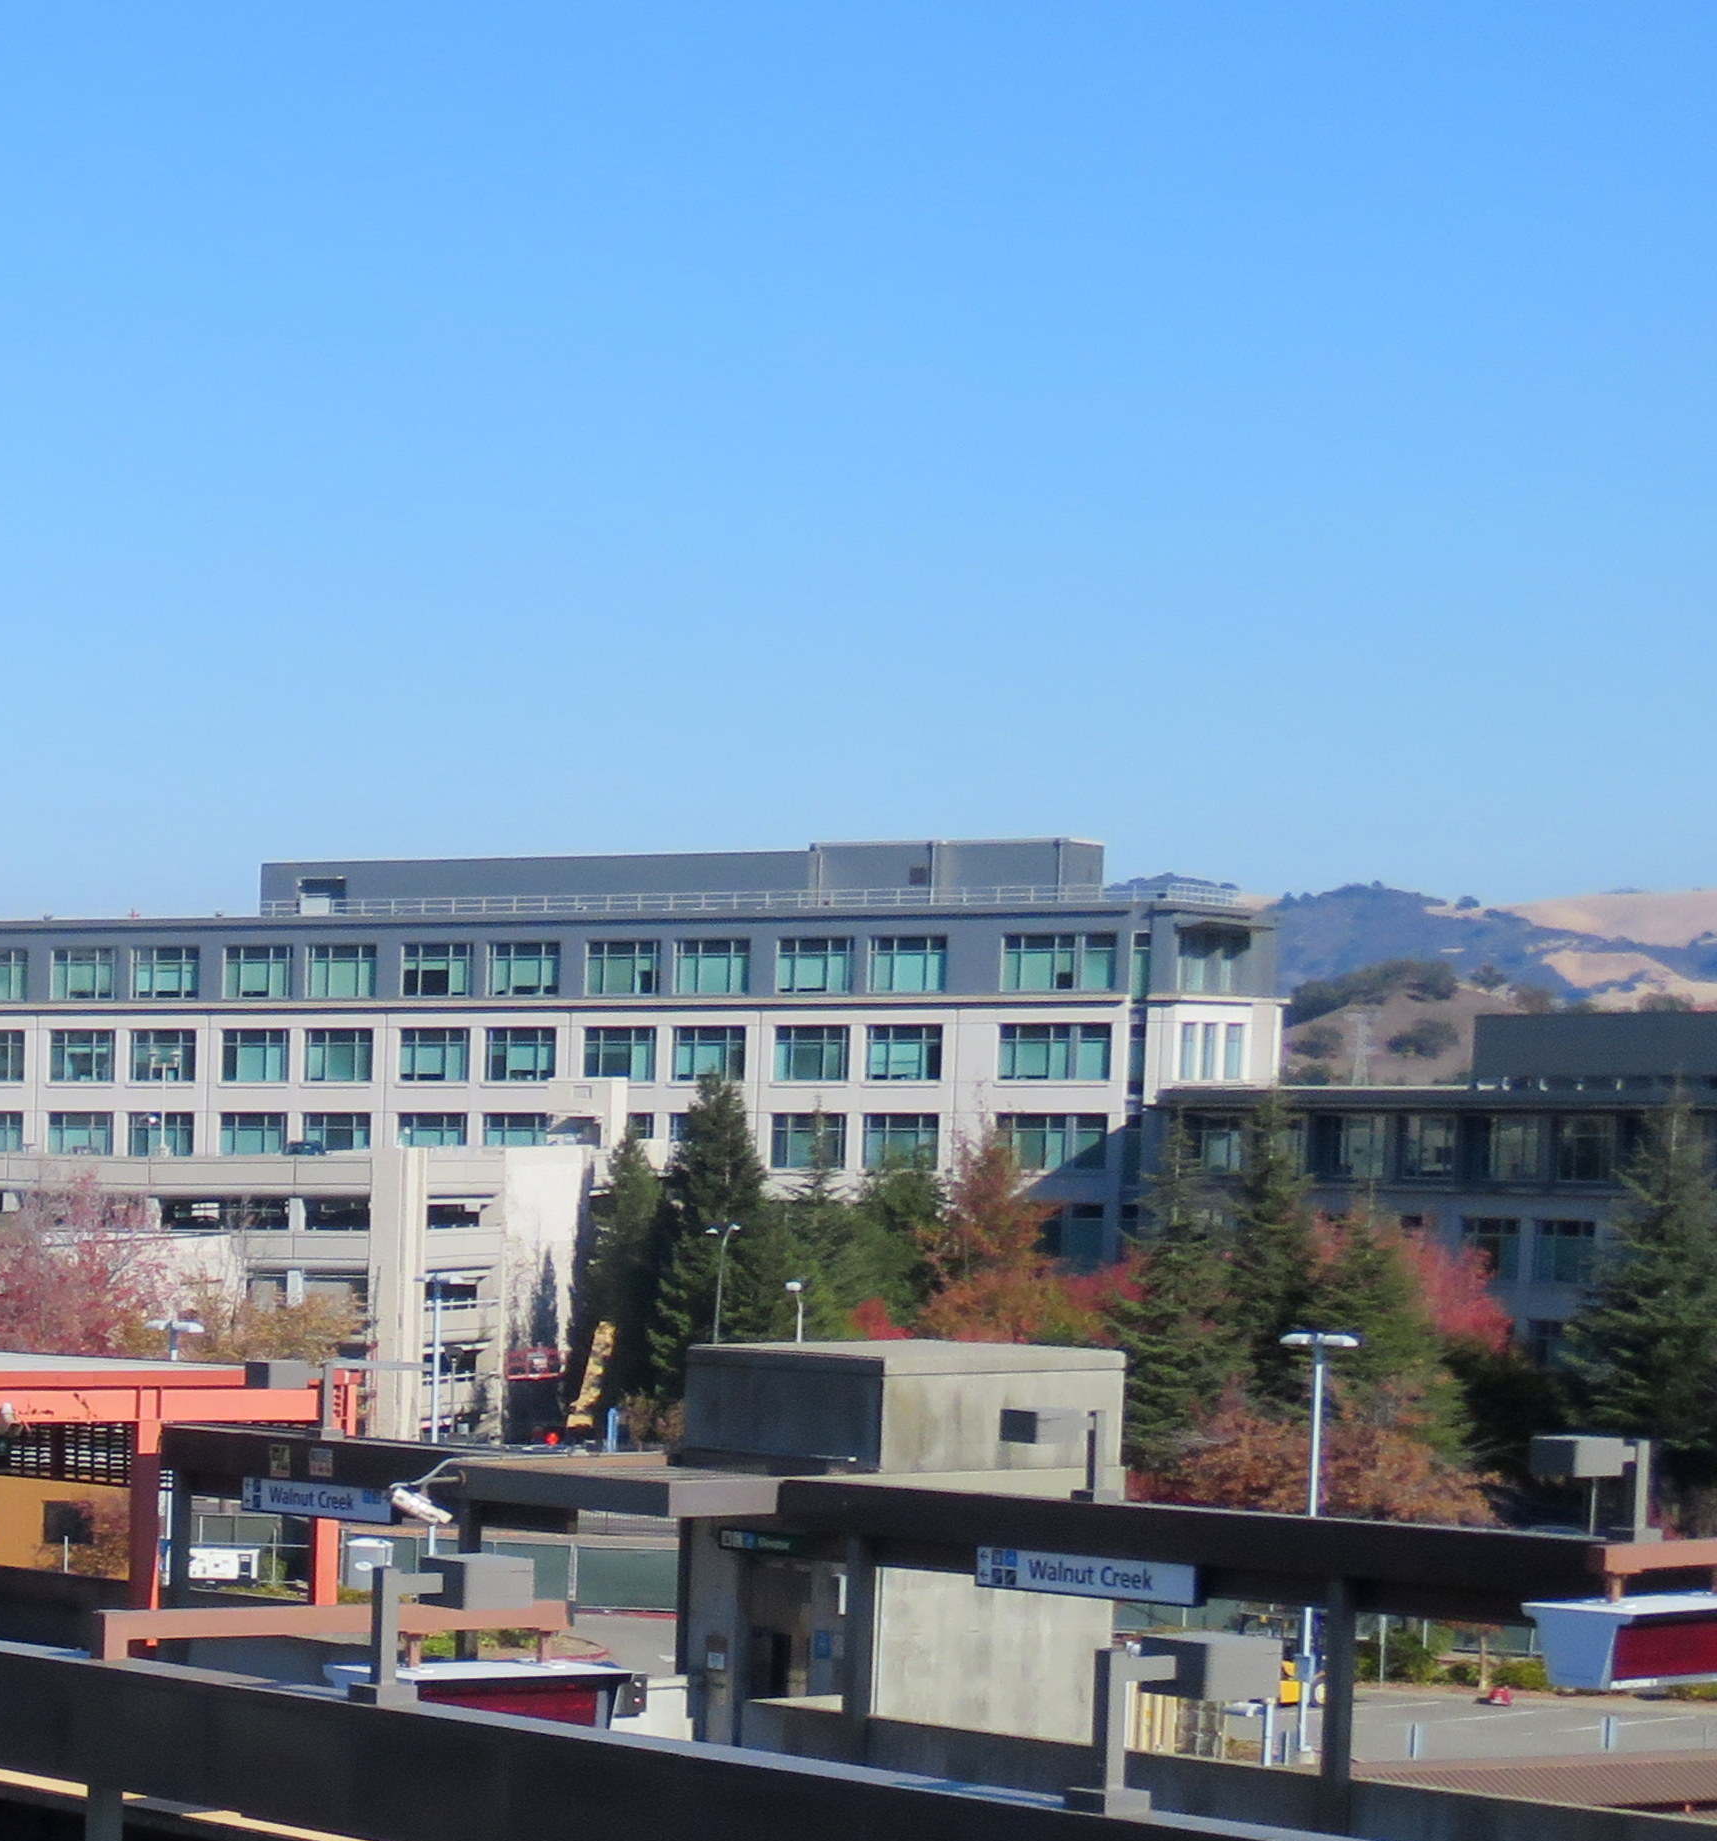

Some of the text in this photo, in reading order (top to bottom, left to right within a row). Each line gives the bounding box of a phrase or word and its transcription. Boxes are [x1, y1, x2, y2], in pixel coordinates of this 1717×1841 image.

[269, 1485, 354, 1511] Walnut Creek
[1028, 1559, 1154, 1592] Walnut Creek
